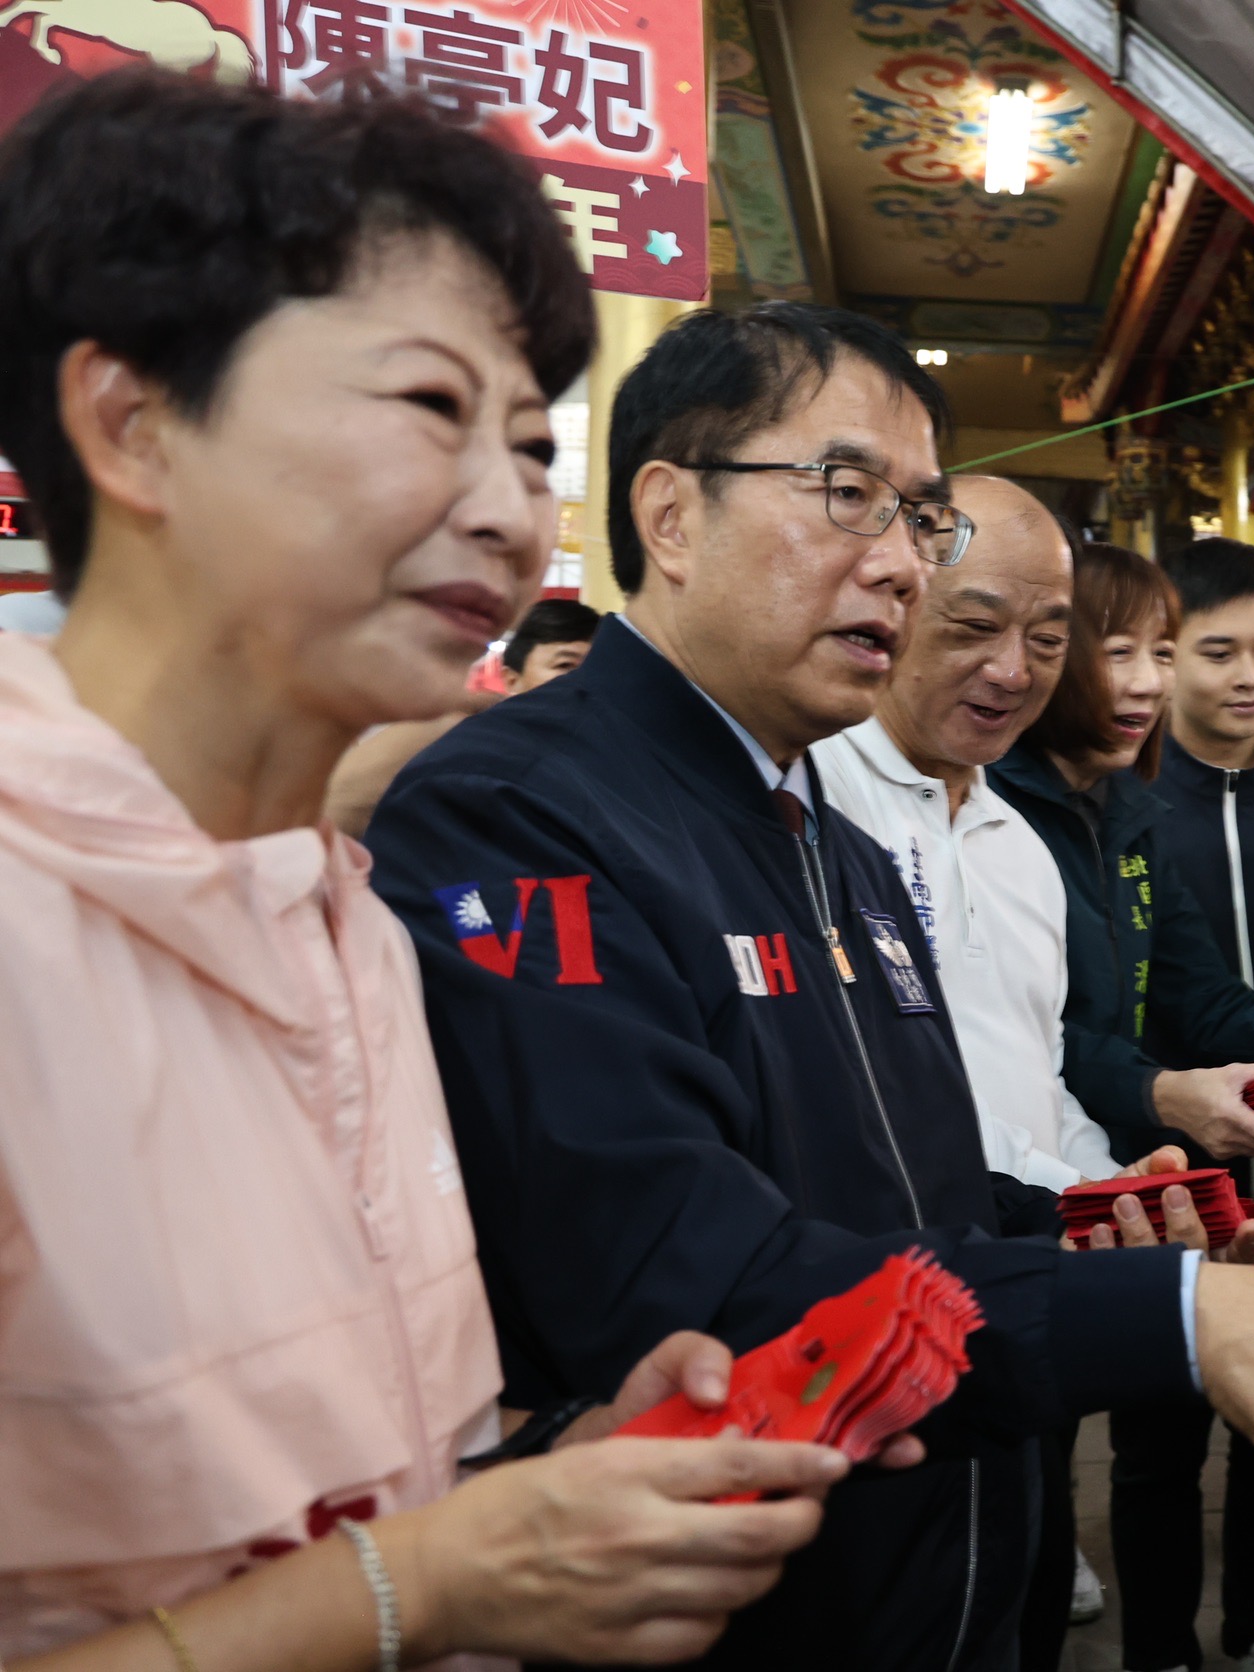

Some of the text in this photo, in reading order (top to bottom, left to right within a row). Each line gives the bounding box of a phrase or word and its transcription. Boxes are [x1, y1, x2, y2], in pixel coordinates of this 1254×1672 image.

[264, 0, 655, 152] 陳亭妃
[542, 173, 628, 275] 年
